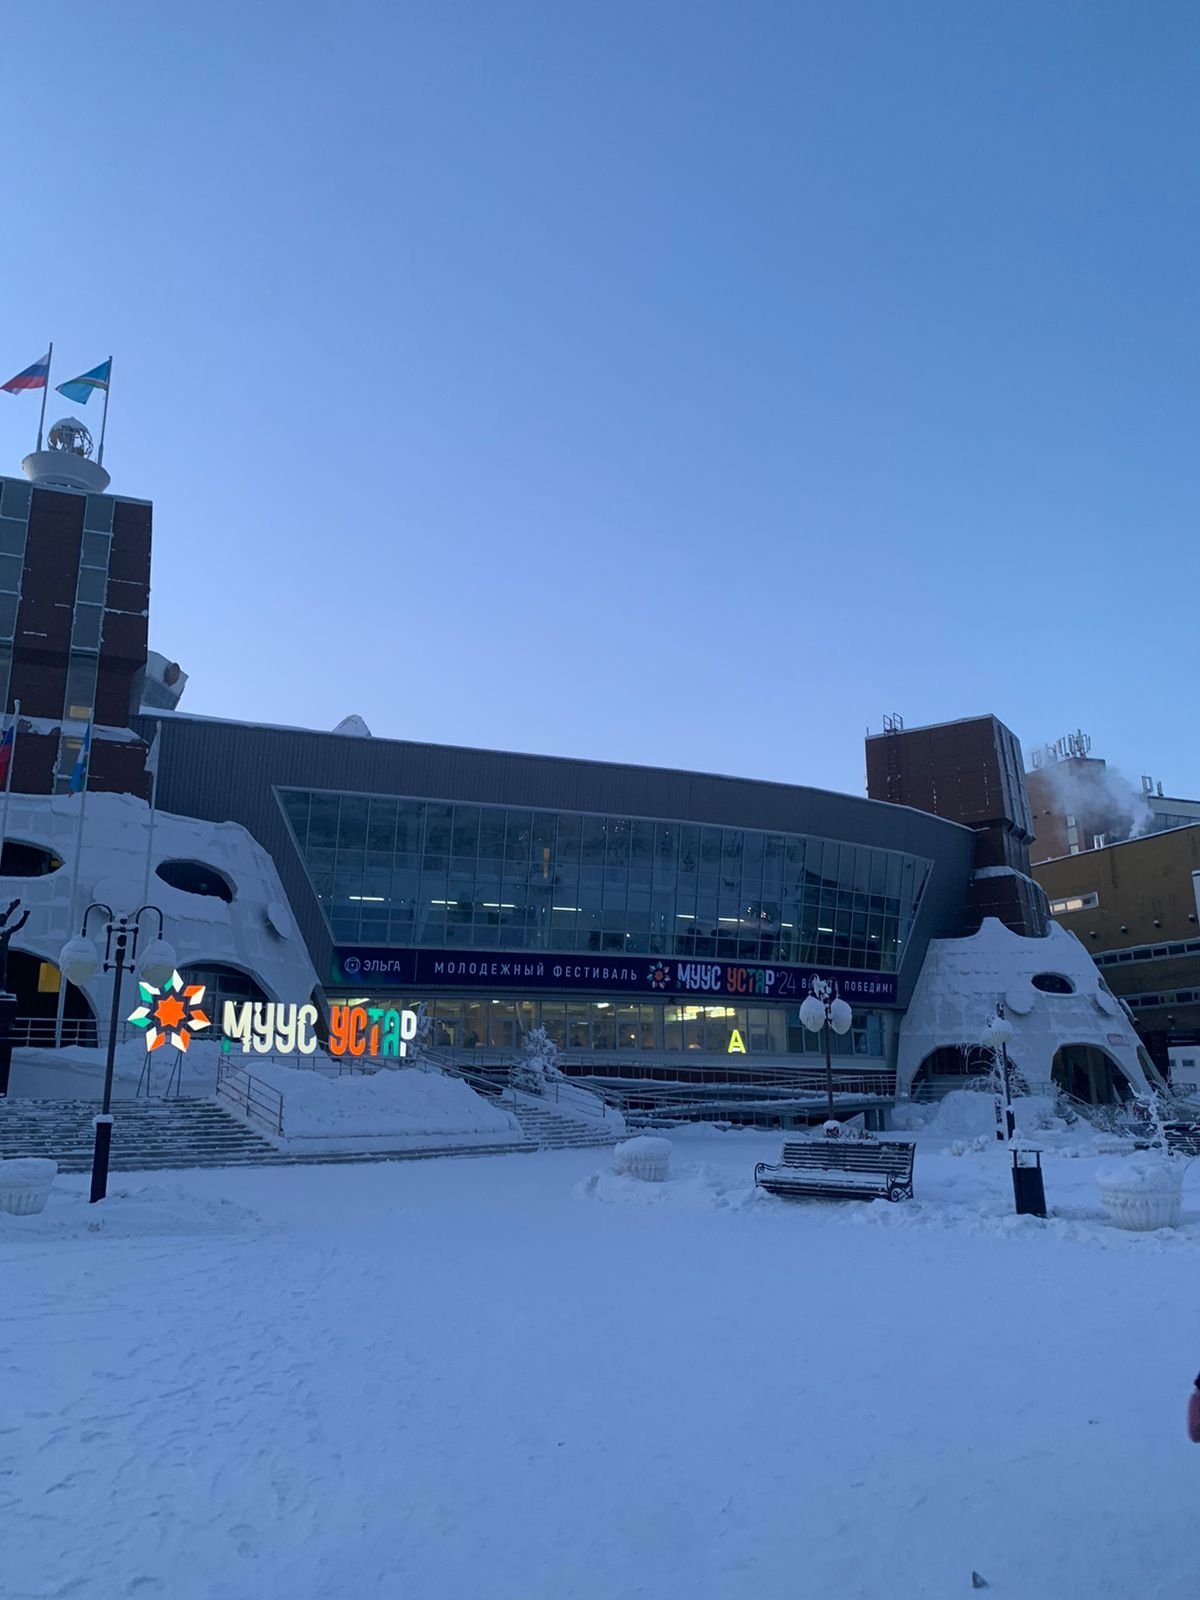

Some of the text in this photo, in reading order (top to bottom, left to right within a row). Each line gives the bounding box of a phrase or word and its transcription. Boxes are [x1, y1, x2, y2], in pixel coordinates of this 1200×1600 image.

[363, 958, 401, 973] ЭЛЬГА
[434, 962, 638, 981] МОЛОДЕЖНЫЙ ФЕСТИВАЛЬ
[677, 963, 722, 991] МУУС
[726, 967, 775, 995] УСТАР
[844, 980, 893, 993] ПОБЕДИМ!
[222, 1002, 418, 1057] МУУС УСТАР
